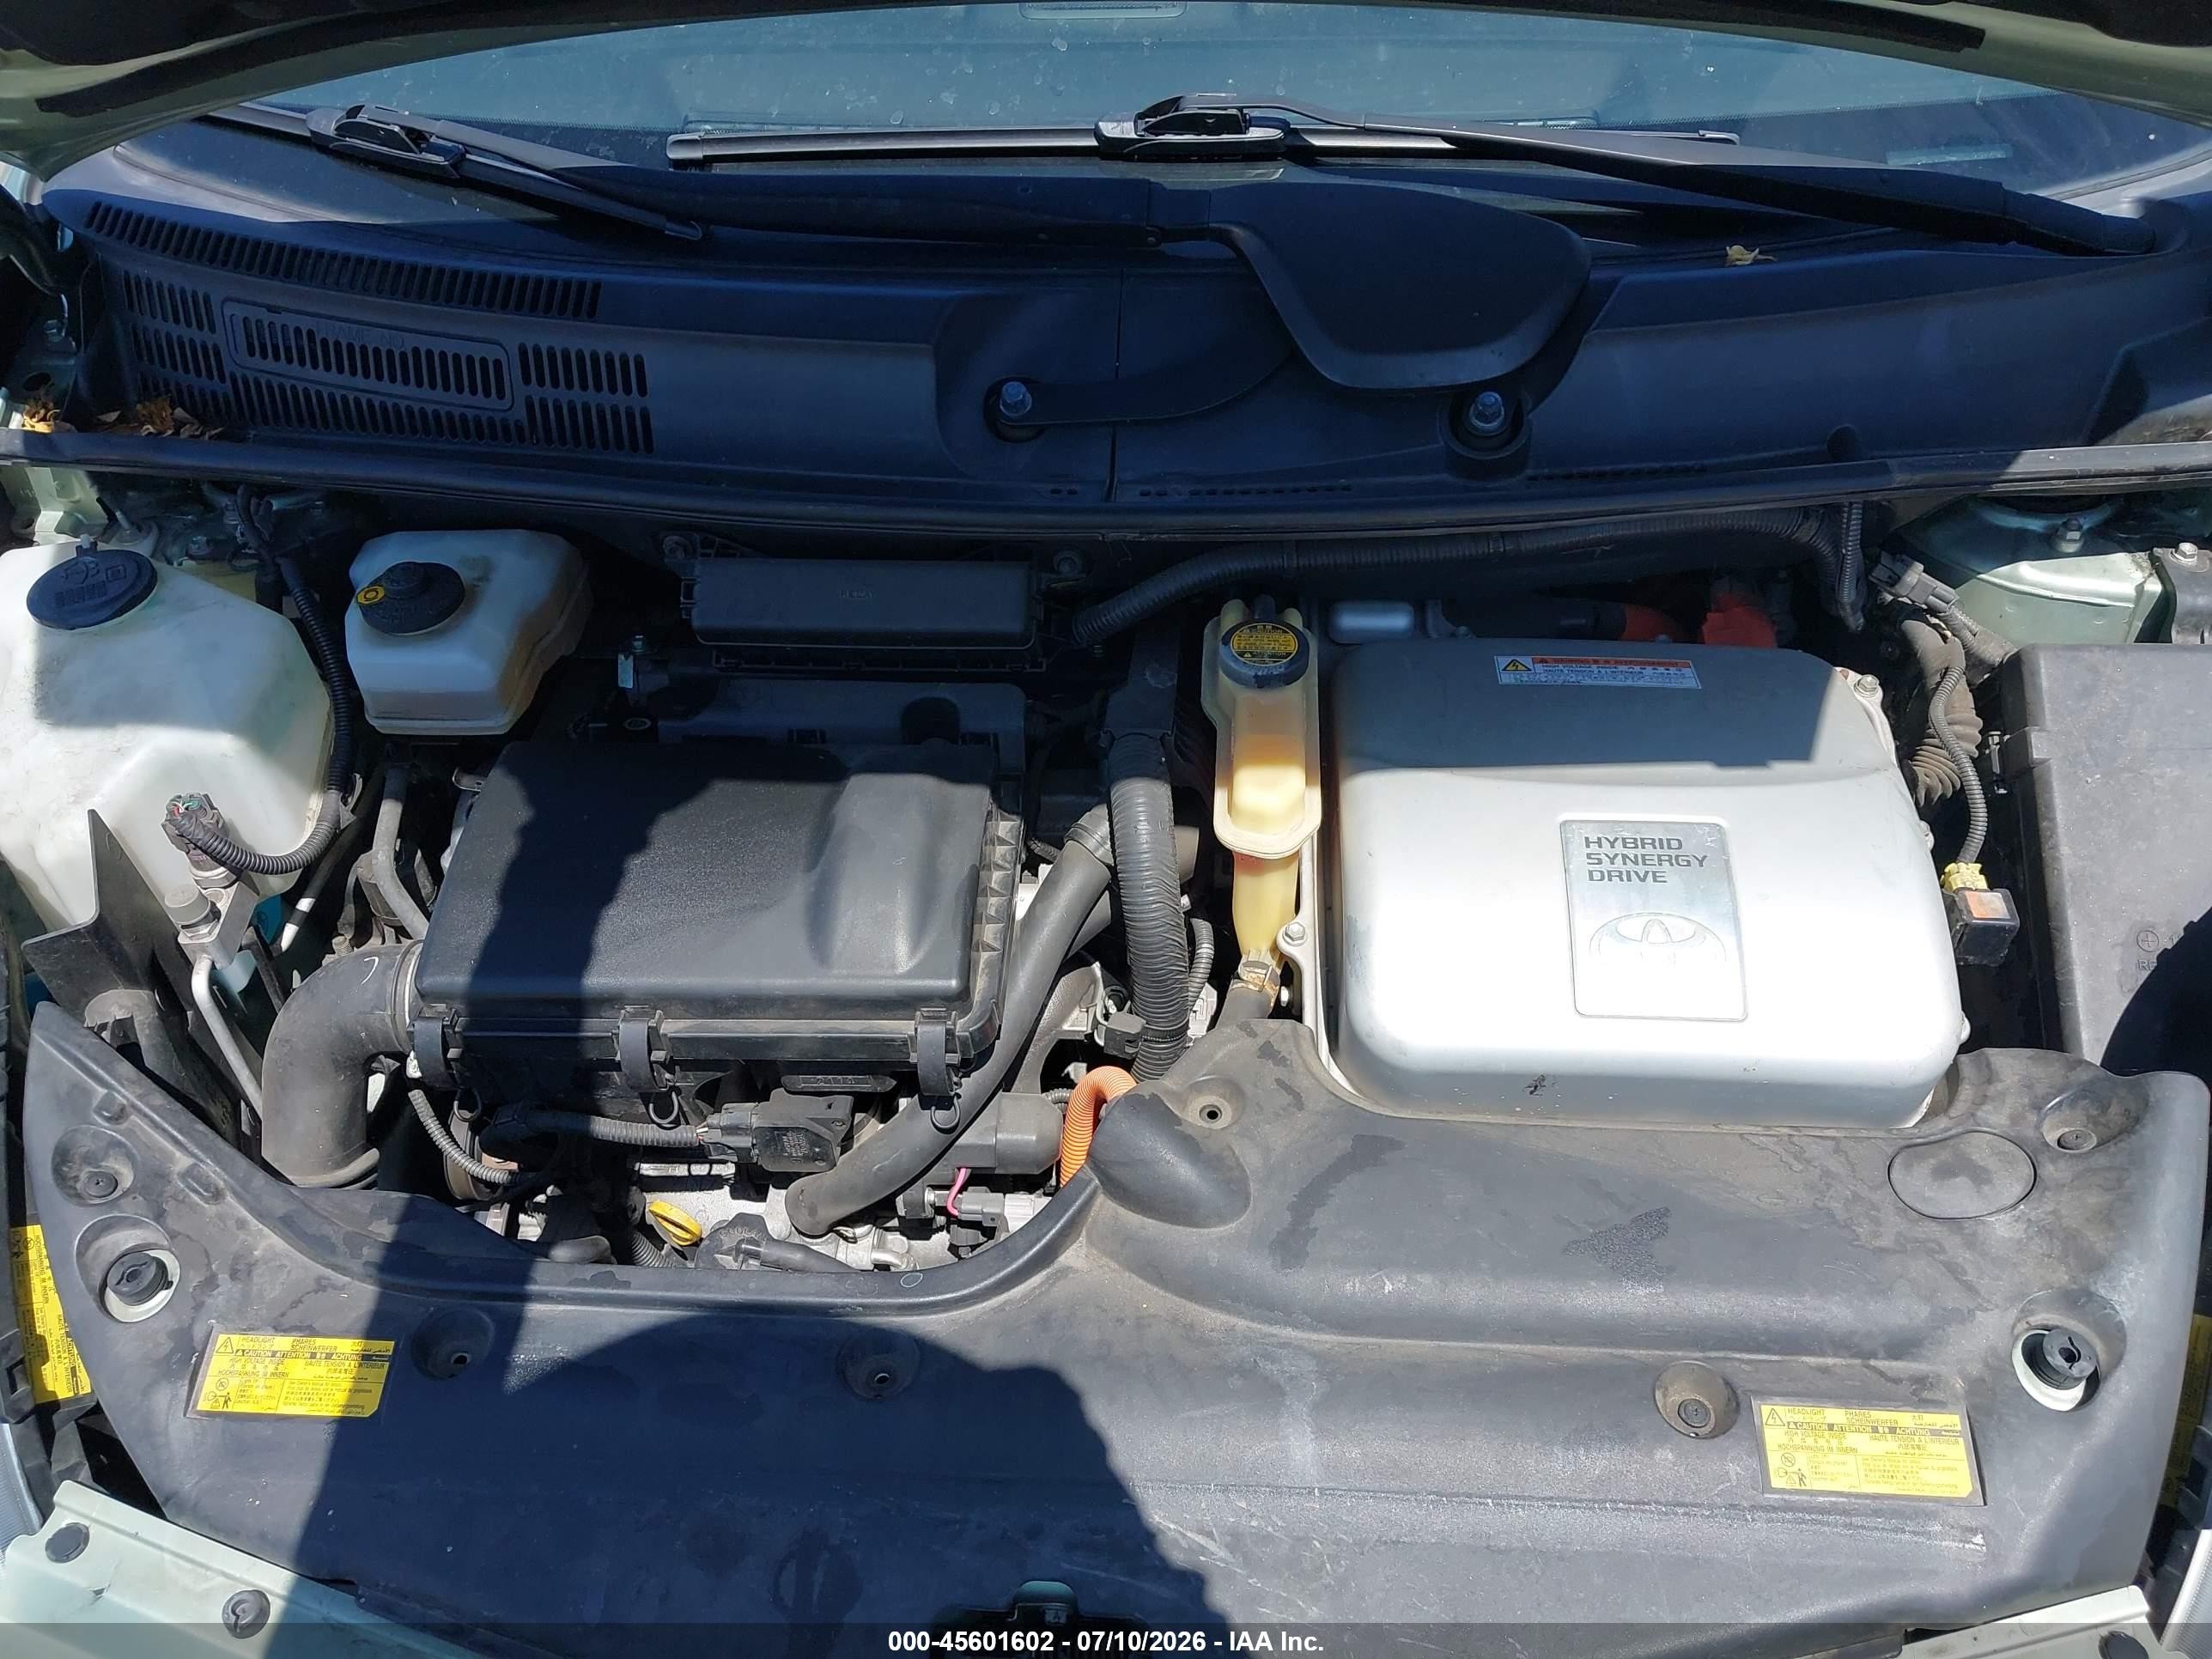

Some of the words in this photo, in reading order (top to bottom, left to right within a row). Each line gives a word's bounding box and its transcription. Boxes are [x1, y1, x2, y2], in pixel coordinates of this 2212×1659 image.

[1584, 836, 1683, 850] HYBRID
[1586, 852, 1708, 867] SYNERGY
[1588, 869, 1668, 883] DRIVE
[1788, 1407, 1826, 1416] HEADLIGHT
[1845, 1410, 1872, 1419] PHARES
[1846, 1418, 1899, 1426] SCHEINWERFER
[1797, 1422, 1828, 1431] CAUTION
[1833, 1424, 1872, 1433] ATTENTION
[1896, 1428, 1930, 1437] ACHTUNG
[1802, 1431, 1826, 1439] VOLTAGE
[1778, 1443, 1826, 1453] HOCHSPANNUNG
